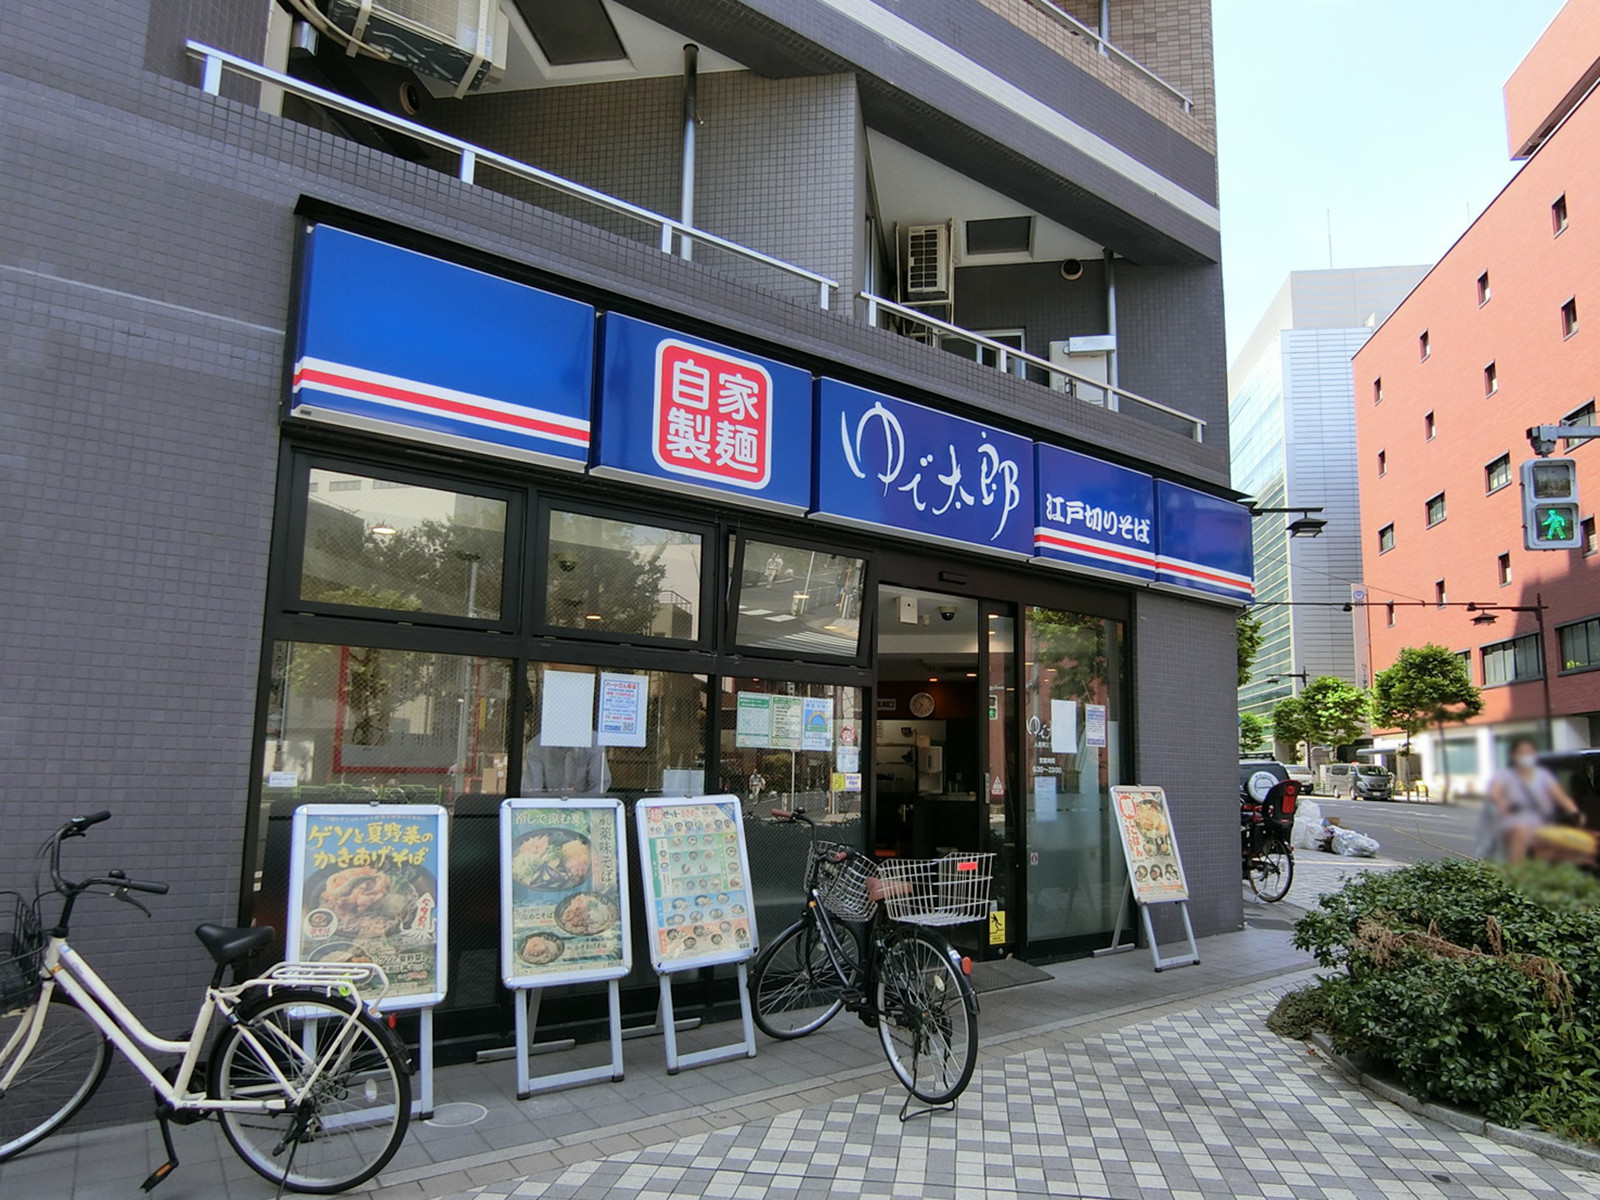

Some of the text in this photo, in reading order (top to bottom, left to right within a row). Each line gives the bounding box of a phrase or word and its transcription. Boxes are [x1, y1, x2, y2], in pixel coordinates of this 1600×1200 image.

[672, 358, 760, 421] 自家
[665, 406, 759, 474] 製麺
[841, 401, 1020, 541] ゆで太郎
[1046, 493, 1151, 544] 江戸切りそば
[309, 822, 433, 848] ゲソと夏野菜の
[313, 847, 429, 869] かきあげそば
